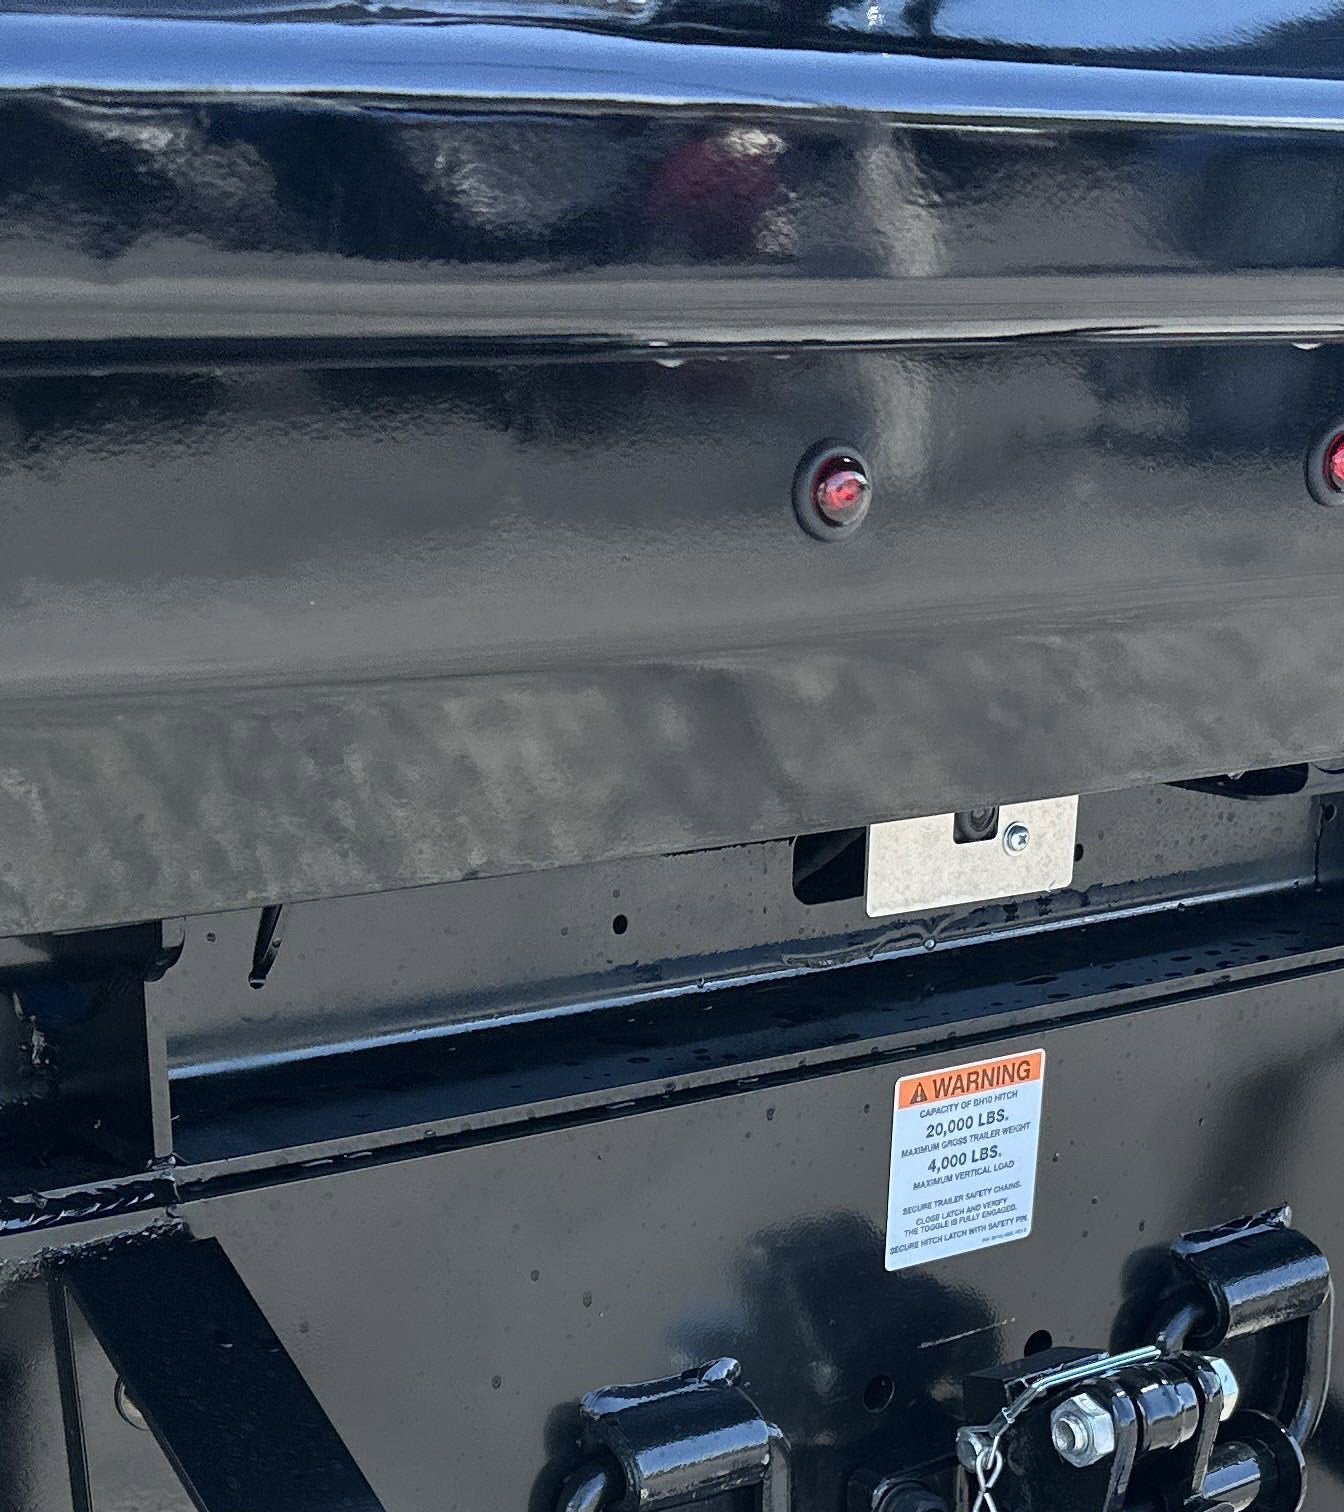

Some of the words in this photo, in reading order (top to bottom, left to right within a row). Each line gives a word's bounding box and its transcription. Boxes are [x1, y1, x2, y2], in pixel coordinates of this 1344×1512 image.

[932, 1060, 1031, 1099] WARNING
[919, 1103, 959, 1119] CAPACITY
[961, 1100, 972, 1111] OF
[994, 1090, 1018, 1103] HITCH
[926, 1115, 974, 1139] 20,000
[978, 1108, 1009, 1127] LBS.
[901, 1142, 940, 1159] MAXIMUM
[941, 1136, 968, 1149] GROSS
[969, 1129, 1001, 1143] TRAILER
[1002, 1121, 1032, 1135] WEIGHT
[927, 1156, 967, 1174] 4,000
[971, 1144, 1002, 1163] LBS.
[912, 1175, 953, 1191] MAXIMUM
[955, 1167, 992, 1181] VERTICAL
[993, 1160, 1015, 1172] LOAD
[902, 1202, 933, 1216] SECURE
[934, 1194, 964, 1209] TRAILER
[965, 1187, 993, 1201] SAFETY
[915, 1213, 941, 1226] CLOSE
[941, 1207, 965, 1220] LATCH
[965, 1203, 982, 1214] AND
[982, 1197, 1009, 1210] VERIFY
[890, 1241, 919, 1255] SECURE
[920, 1234, 943, 1247] HITCH
[944, 1228, 968, 1241] LATCH
[968, 1224, 987, 1236] WITH
[987, 1218, 1014, 1231] SAFETY
[904, 1227, 919, 1238] THE
[920, 1221, 950, 1234] TOGGLE
[958, 1213, 981, 1225] FULLY
